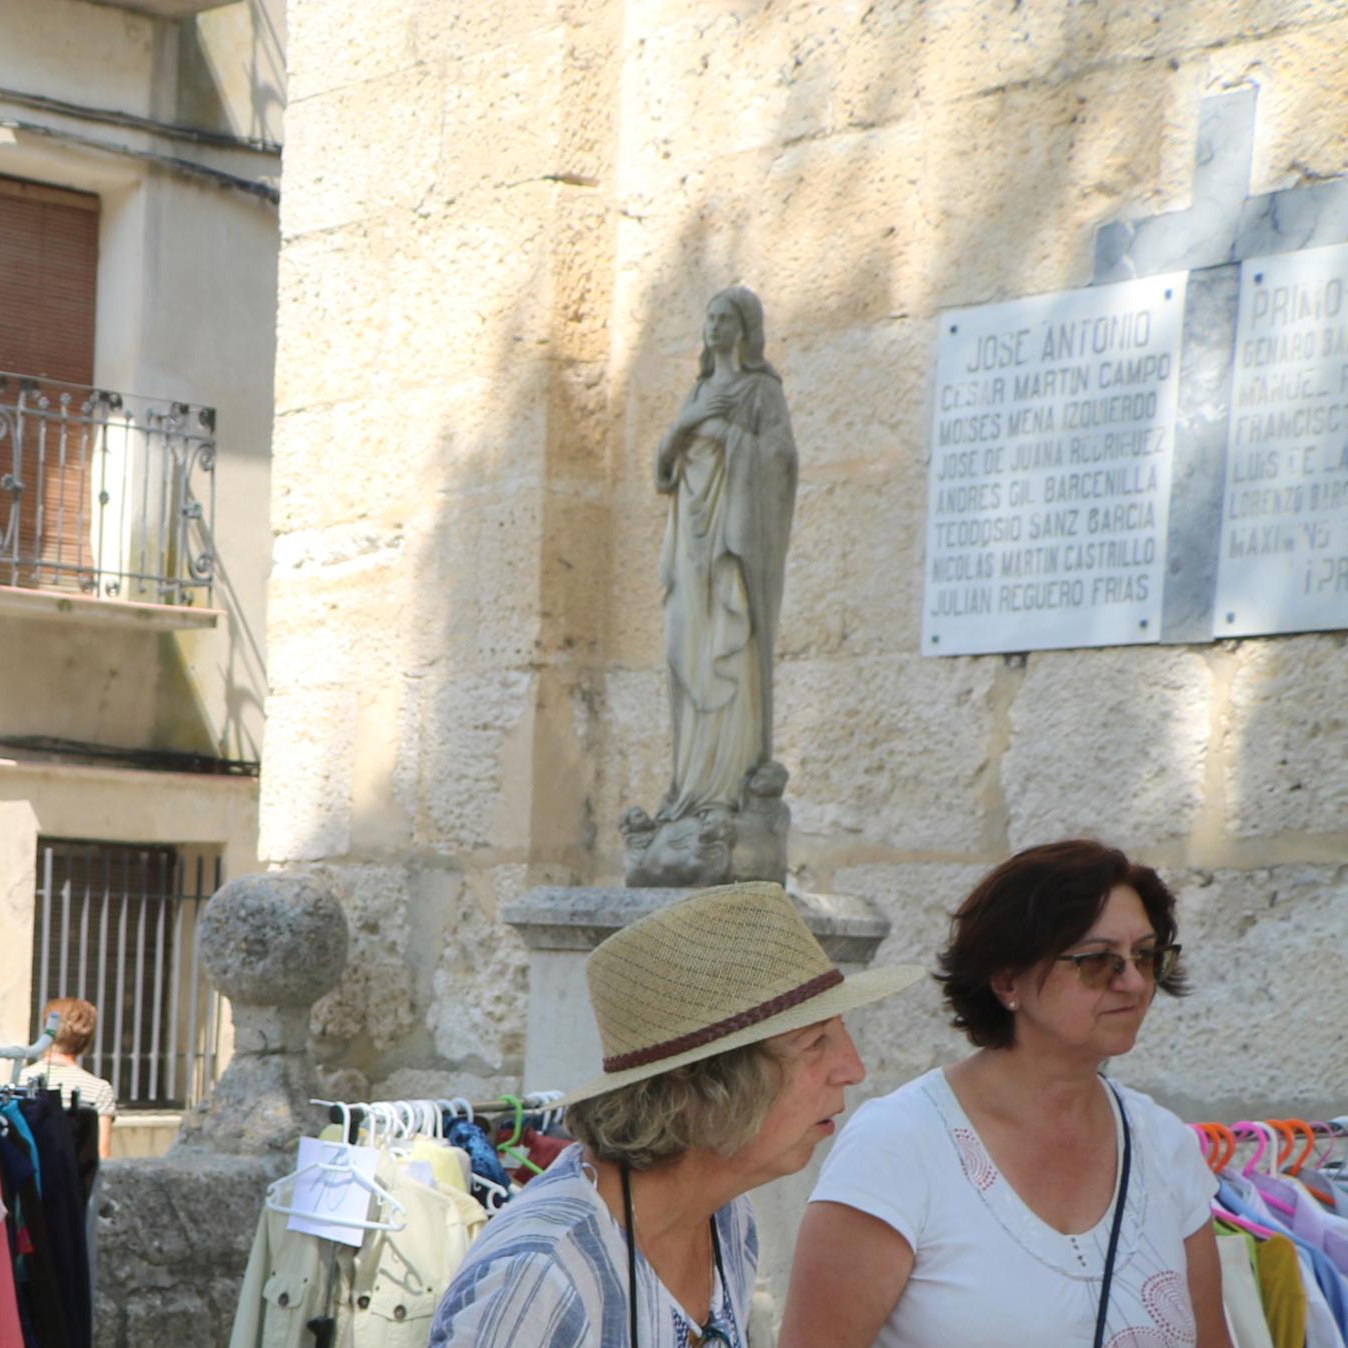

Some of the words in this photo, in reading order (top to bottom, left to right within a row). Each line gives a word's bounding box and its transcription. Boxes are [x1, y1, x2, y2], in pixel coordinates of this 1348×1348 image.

[1251, 277, 1343, 331] PRIMO
[966, 328, 1031, 374] JOSE
[1040, 310, 1151, 363] ANTONIO
[1242, 330, 1315, 369] GENARO
[941, 377, 1005, 412] CESAR
[1013, 364, 1090, 402] MARTIN
[1098, 352, 1172, 389] CAMPO
[938, 412, 1002, 447] MOISES
[1007, 404, 1055, 438] MENA
[1062, 390, 1157, 431] IZQUIERDO
[937, 449, 978, 481] JOSE
[982, 446, 1005, 476] DE
[1010, 437, 1063, 472] JUANA
[1069, 425, 1166, 464] RODRIGUEZ
[1232, 449, 1279, 484] LUIS
[936, 482, 1002, 516] ANDRES
[1009, 479, 1036, 508] GIL
[1044, 463, 1158, 503] BARCENILLA
[1229, 483, 1304, 521] LORENZO
[935, 515, 1022, 548] TEODOSIO
[1029, 508, 1080, 540] SANZ
[932, 552, 995, 583] NICOLAS
[1000, 544, 1060, 577] MARTIN
[1064, 537, 1156, 572] CASTRILLO
[930, 586, 993, 618] JULIAN
[998, 578, 1084, 613] REGUERO
[1092, 573, 1150, 606] FRIAS
